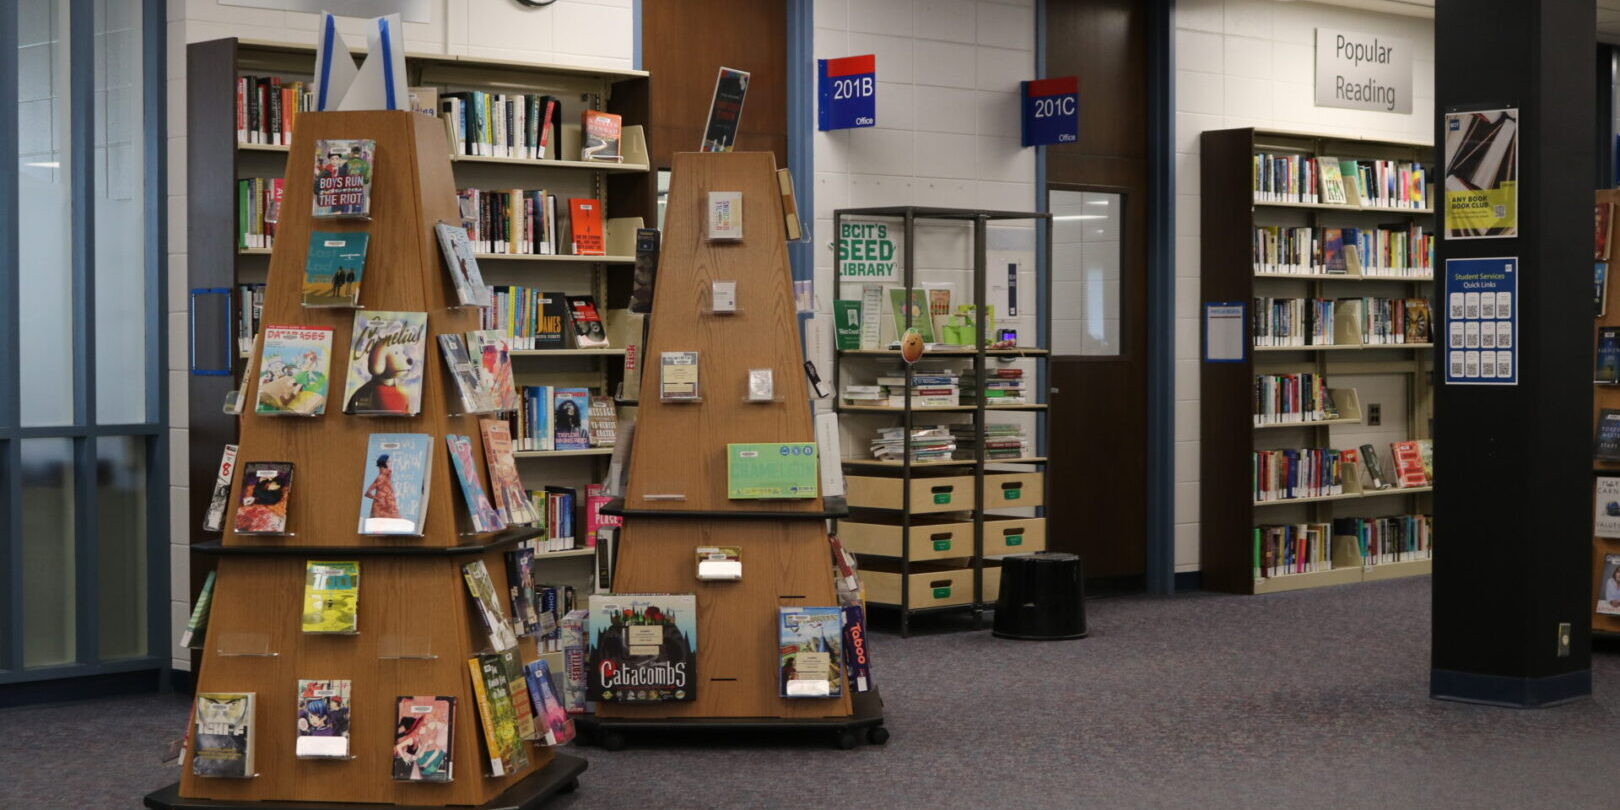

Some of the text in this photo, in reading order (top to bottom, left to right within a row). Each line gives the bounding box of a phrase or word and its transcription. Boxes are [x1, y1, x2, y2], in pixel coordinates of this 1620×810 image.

[1336, 34, 1393, 66] Popular
[834, 77, 873, 99] 201B
[1336, 75, 1396, 111] Reading
[1035, 97, 1076, 118] 201C
[855, 117, 874, 126] Office
[1058, 133, 1076, 142] Office
[320, 176, 364, 189] BOYS RUN
[320, 193, 362, 206] THE RIOT
[841, 223, 887, 239] BCIT'S
[838, 239, 894, 261] SEED
[1463, 281, 1480, 289] Quick
[535, 292, 561, 334] JAMES
[626, 344, 636, 370] Risk
[850, 622, 866, 664] Taboo
[600, 660, 686, 689] Catacombs
